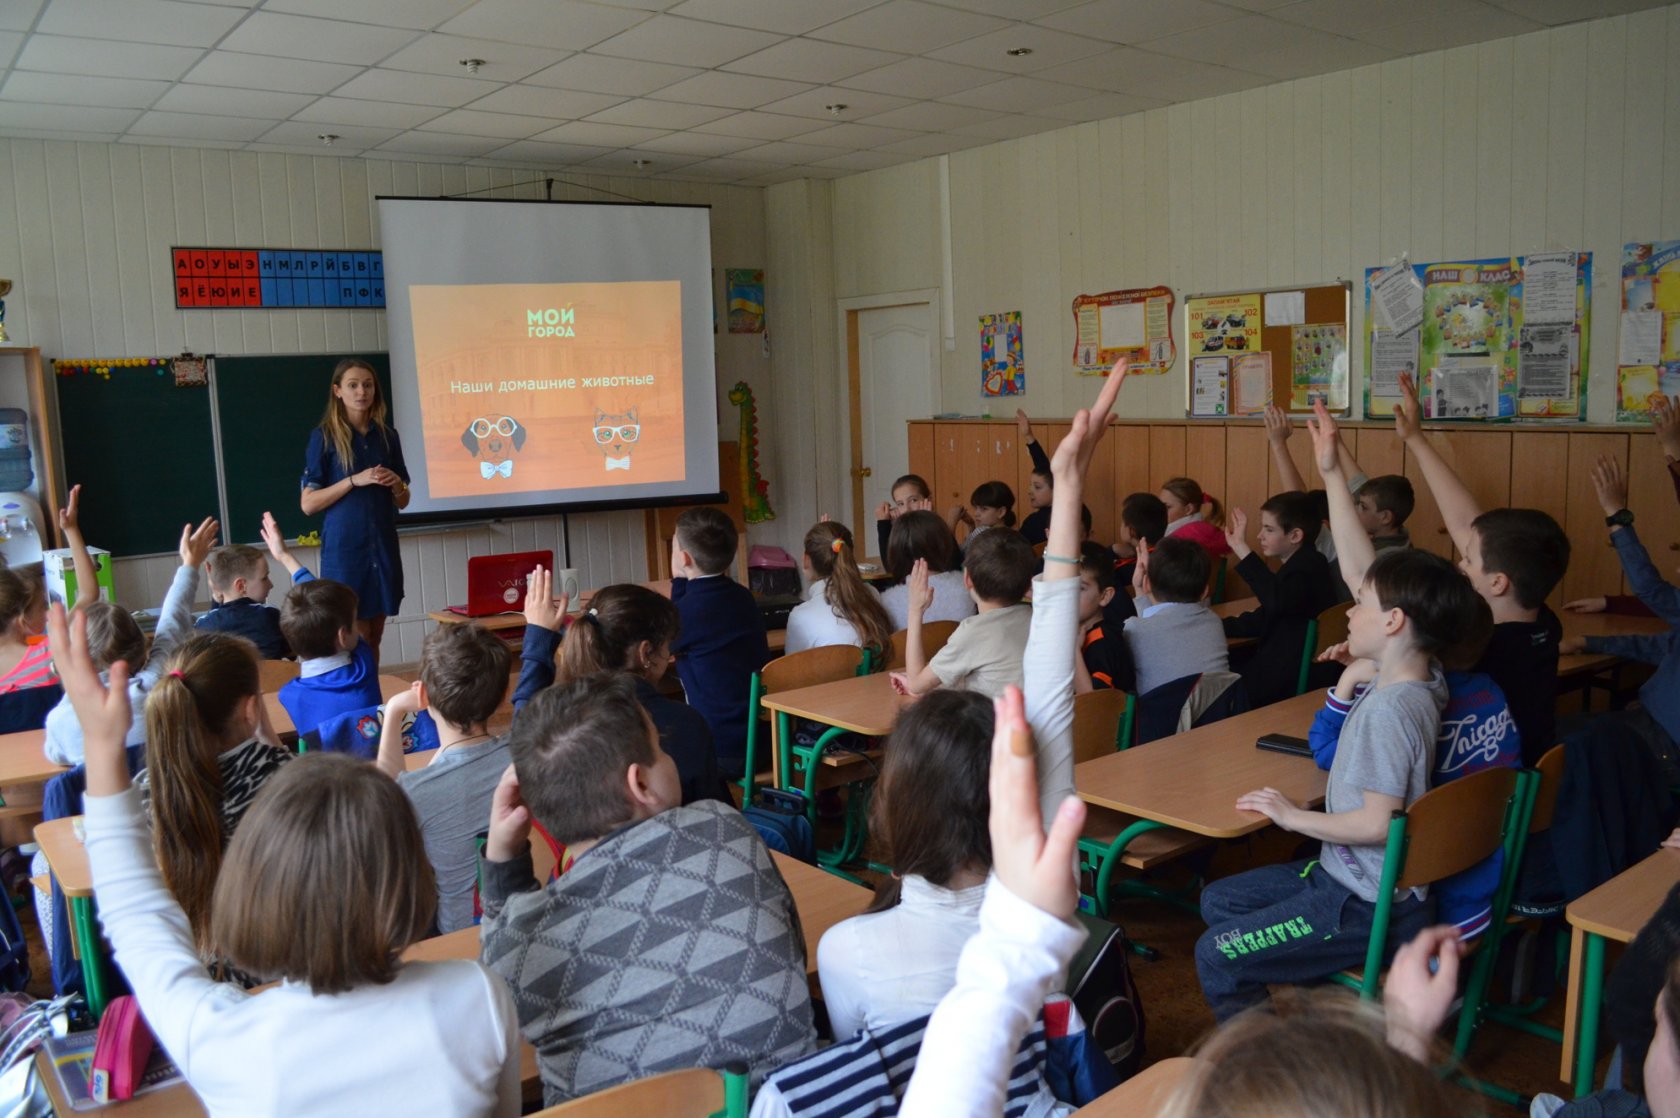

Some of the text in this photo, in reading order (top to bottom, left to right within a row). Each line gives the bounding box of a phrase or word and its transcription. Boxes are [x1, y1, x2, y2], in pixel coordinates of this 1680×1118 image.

[1432, 270, 1511, 282] НАШ КЛАС
[527, 302, 575, 326] МОЙ
[1191, 312, 1204, 320] 101
[1244, 308, 1257, 317] 102
[528, 325, 575, 338] ГОРОД
[1244, 328, 1257, 337] 104
[450, 373, 655, 394] Наши домашние животные
[1214, 928, 1242, 950] BOY
[1219, 915, 1313, 960] TRAPPERS
